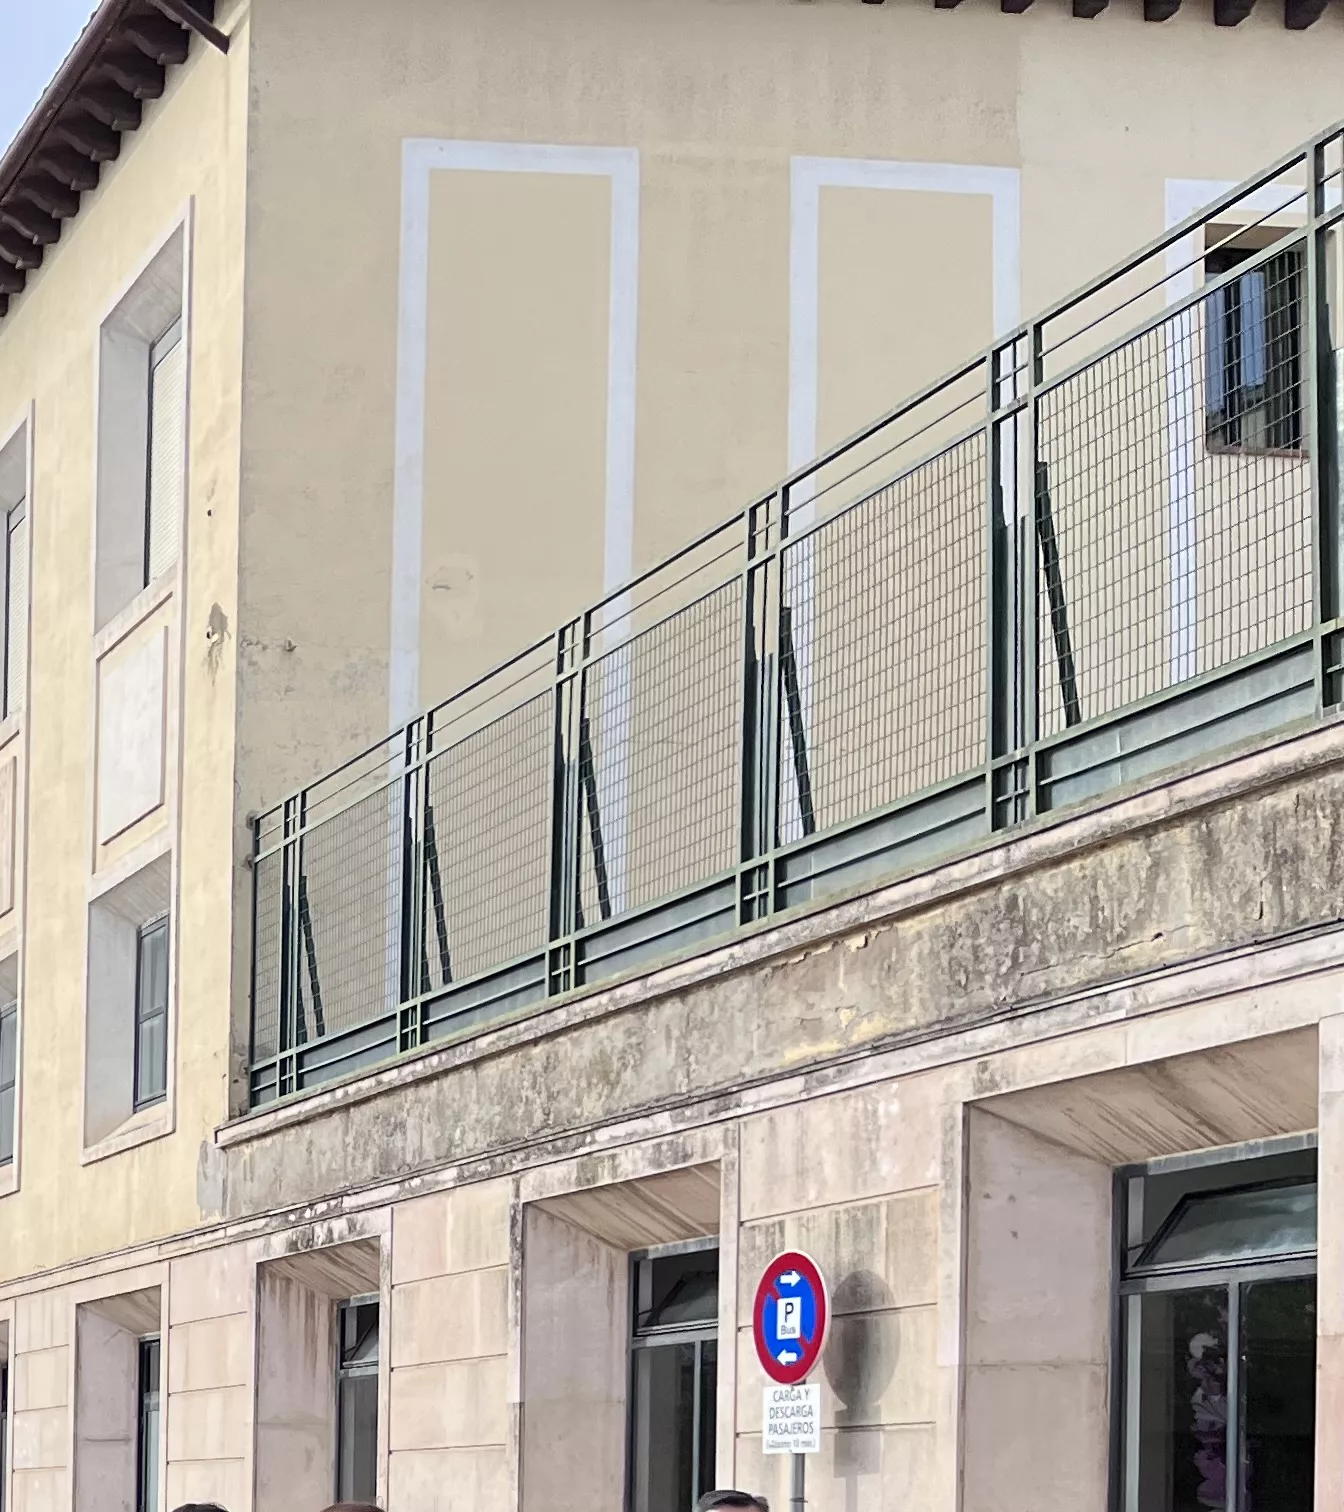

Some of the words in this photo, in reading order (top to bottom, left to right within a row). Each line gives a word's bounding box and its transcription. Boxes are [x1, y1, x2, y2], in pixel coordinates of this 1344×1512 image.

[784, 1302, 794, 1323] P
[780, 1325, 796, 1335] Bus
[773, 1390, 802, 1402] CARGA
[804, 1388, 810, 1400] Y
[769, 1405, 813, 1419] DESCARGA
[768, 1422, 813, 1435] PASAJEROS
